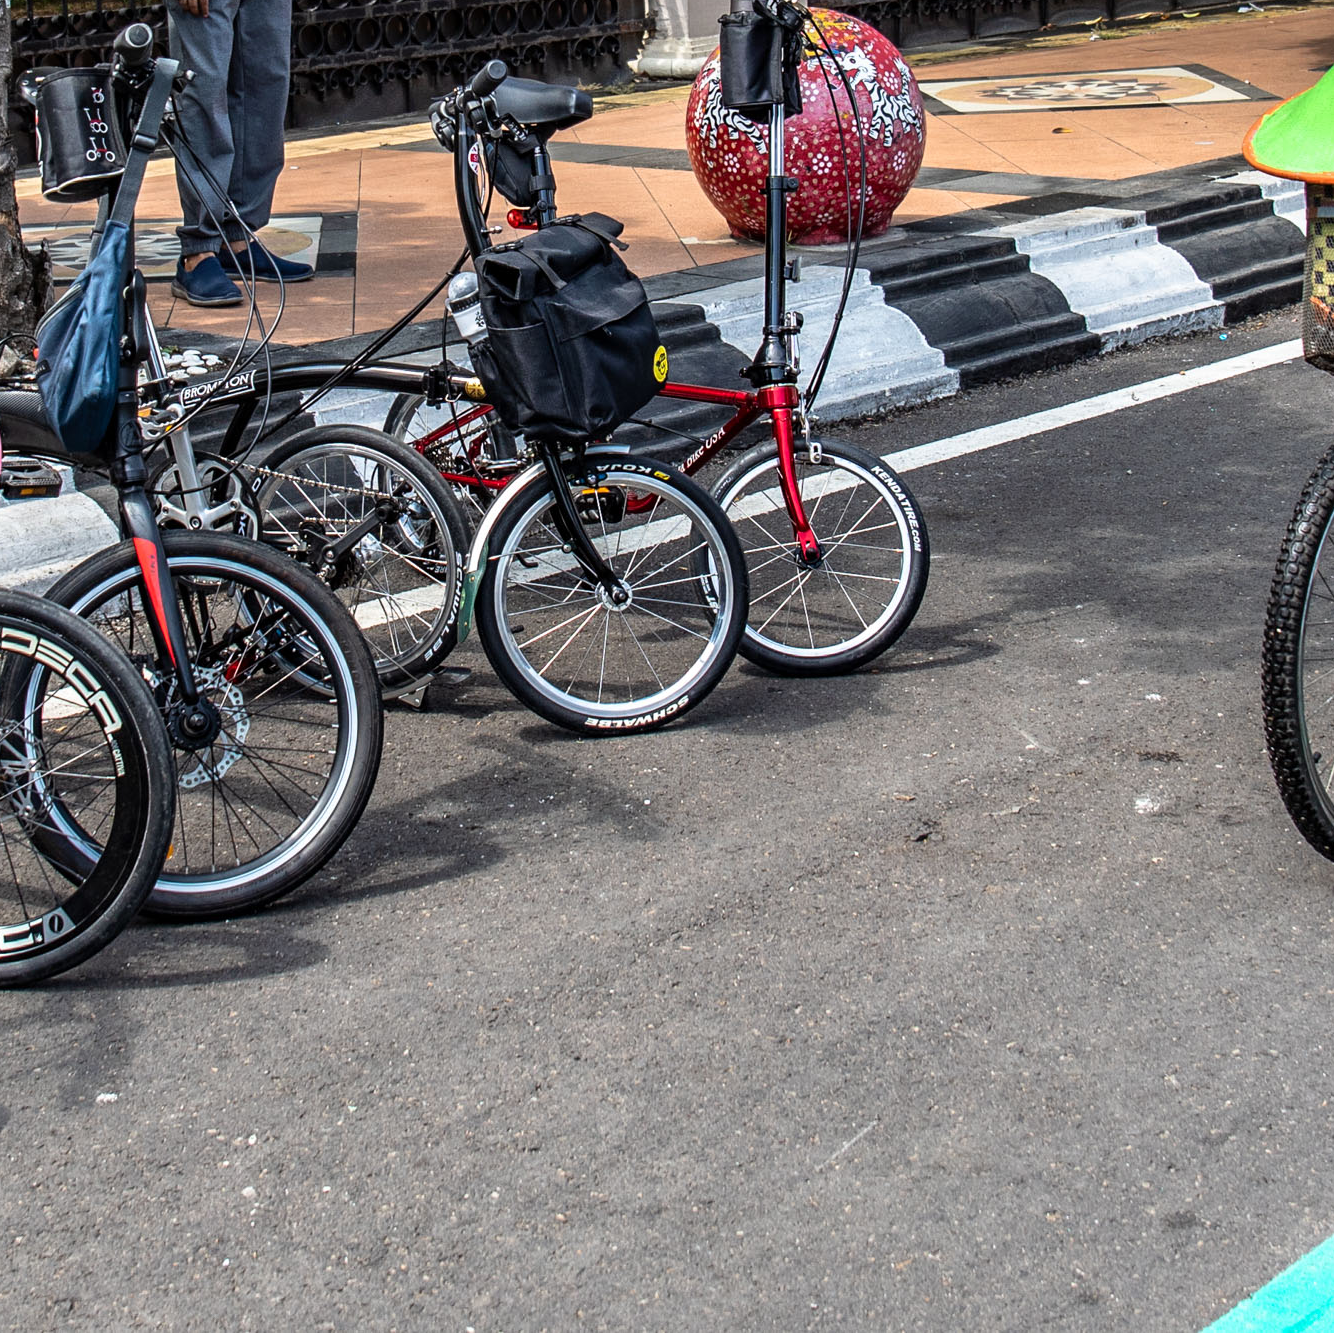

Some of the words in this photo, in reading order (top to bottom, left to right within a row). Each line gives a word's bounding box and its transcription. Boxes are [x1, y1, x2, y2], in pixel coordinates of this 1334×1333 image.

[596, 463, 652, 474] KOJA
[870, 465, 922, 553] KENDATIRE.COM
[424, 550, 463, 662] SCHWALBE
[584, 694, 690, 728] SCHWALBE
